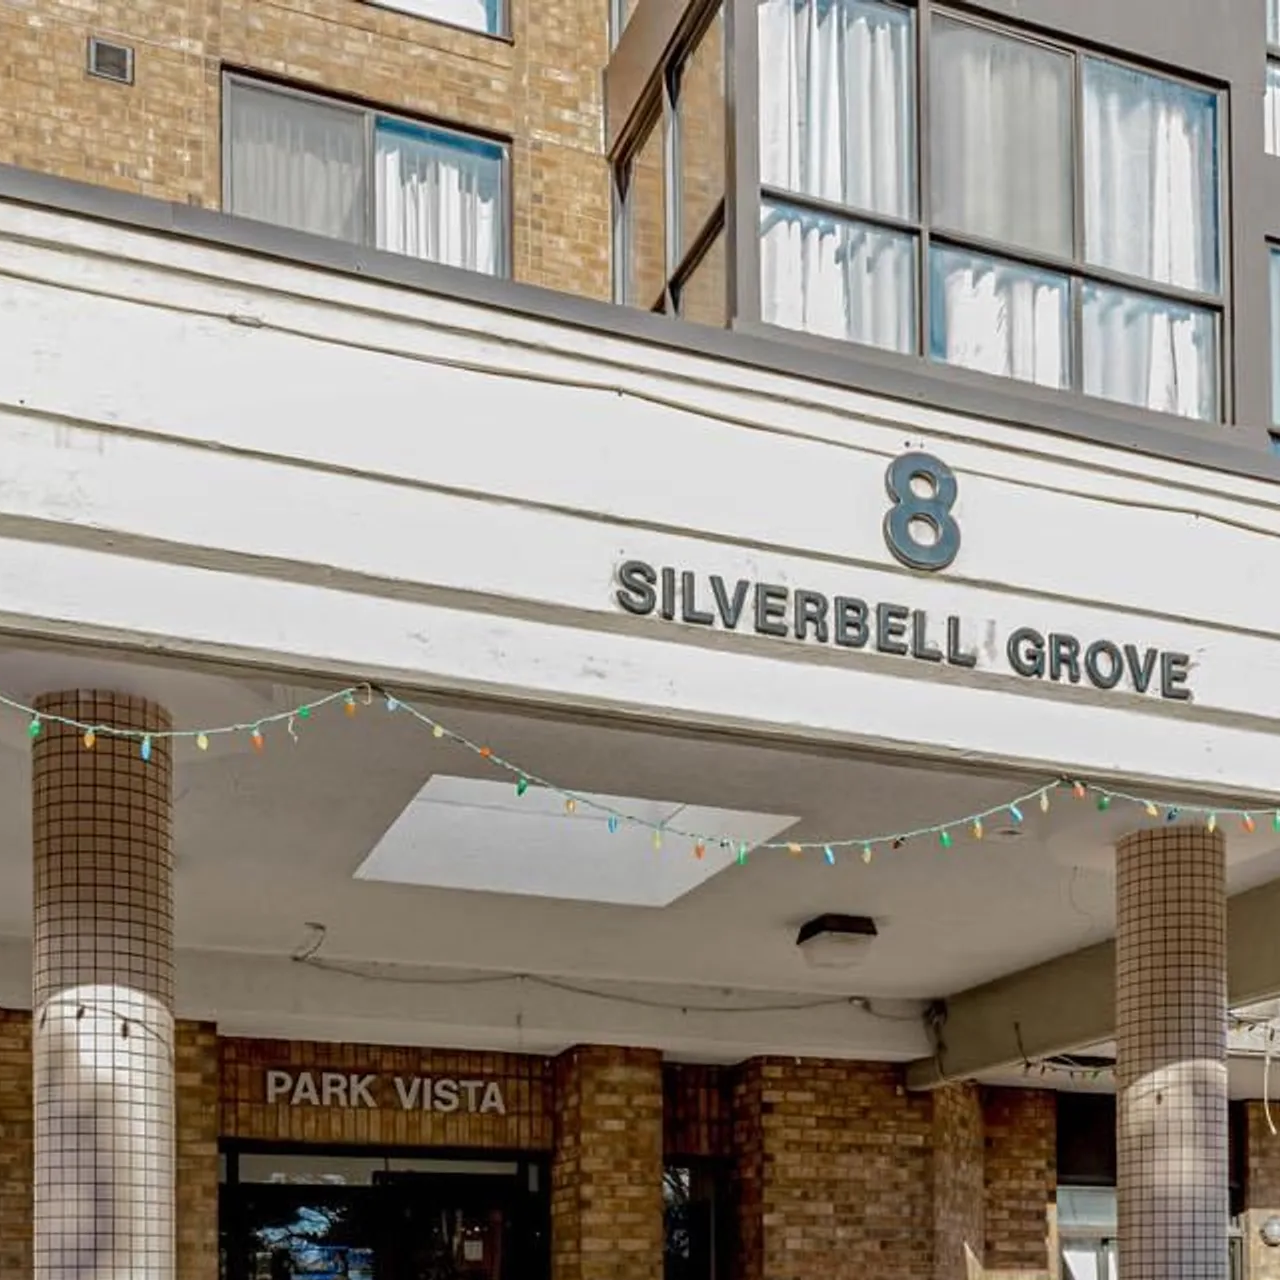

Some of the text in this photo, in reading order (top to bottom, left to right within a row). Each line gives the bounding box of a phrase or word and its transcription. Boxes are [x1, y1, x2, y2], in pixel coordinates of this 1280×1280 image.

[883, 452, 961, 571] 8
[616, 560, 1192, 700] SILVERBELL GROVE
[267, 1070, 506, 1115] PARK VISTA
